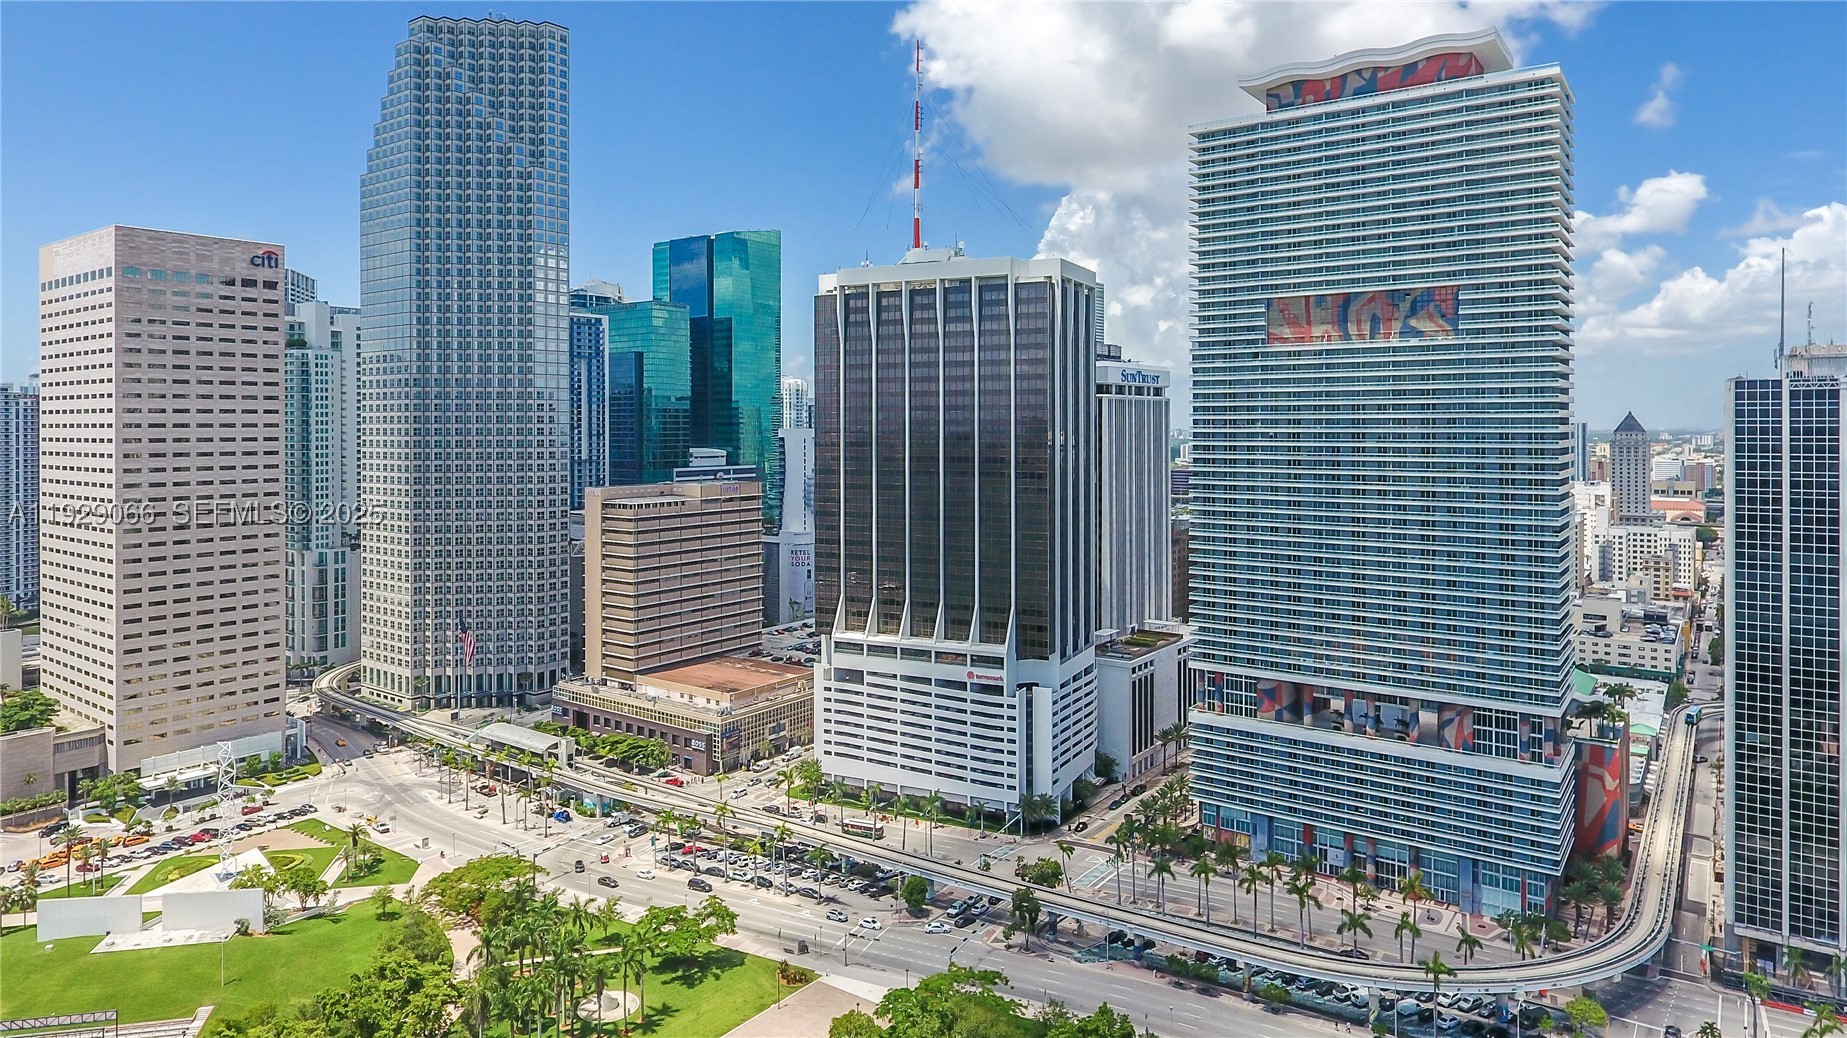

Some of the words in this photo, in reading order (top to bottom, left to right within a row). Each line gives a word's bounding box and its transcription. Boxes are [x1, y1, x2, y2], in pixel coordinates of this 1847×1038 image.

[250, 249, 279, 269] citi
[975, 673, 1004, 682] terremark
[691, 739, 706, 748] ROSS
